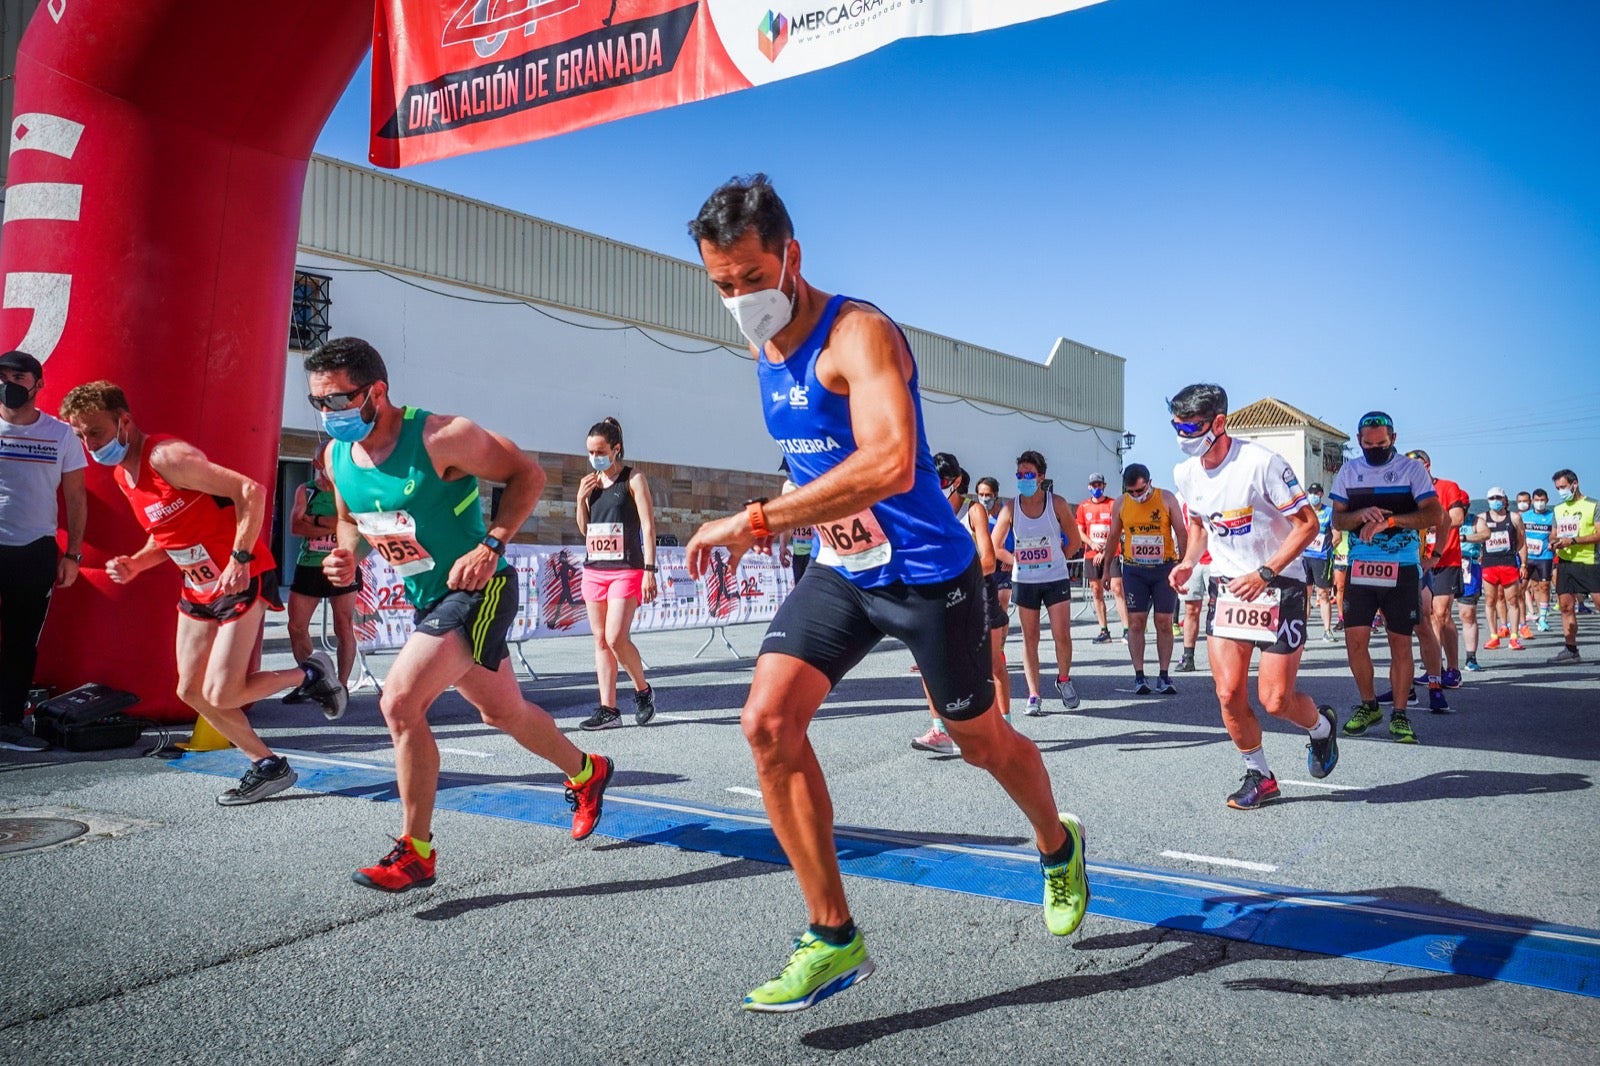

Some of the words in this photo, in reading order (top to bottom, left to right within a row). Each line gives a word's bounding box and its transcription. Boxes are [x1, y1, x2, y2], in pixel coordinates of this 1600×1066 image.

[790, 0, 884, 36] MERCAGRA
[408, 66, 520, 130] DIPUTACIÓN
[524, 65, 549, 101] DE
[555, 28, 663, 93] GRANADA
[0, 439, 58, 453] hampion
[817, 517, 873, 550] 064
[376, 540, 421, 562] 055
[591, 539, 618, 551] 1021
[1136, 546, 1161, 556] 2023
[1020, 549, 1049, 561] 2059
[1358, 563, 1394, 578] 1090
[1225, 607, 1273, 628] 1089
